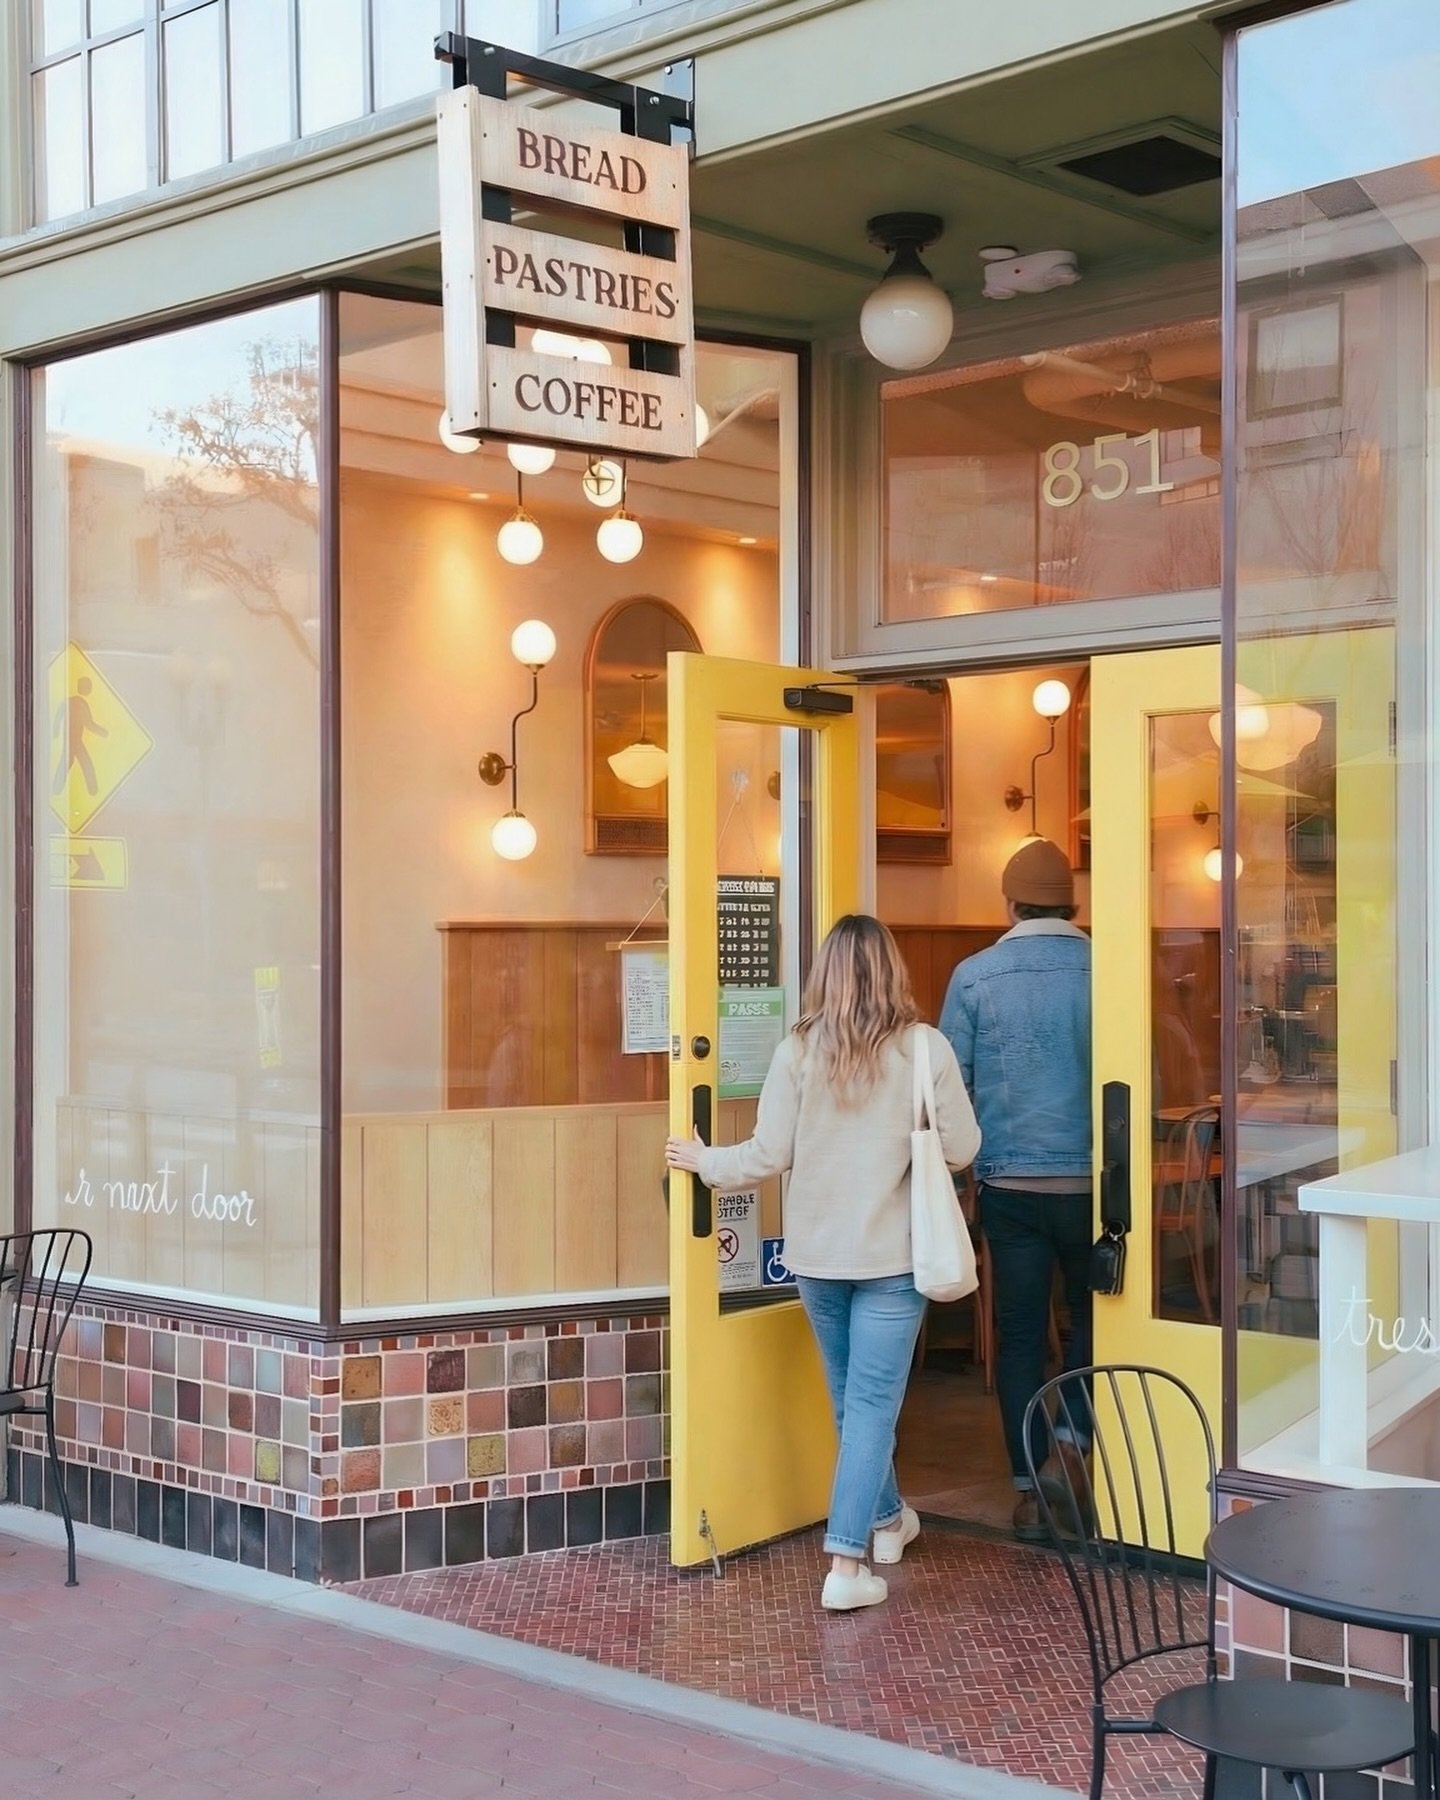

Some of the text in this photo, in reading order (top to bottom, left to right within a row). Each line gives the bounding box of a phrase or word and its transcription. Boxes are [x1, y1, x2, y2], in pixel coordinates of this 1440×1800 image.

[517, 127, 646, 194] BREAD
[492, 245, 676, 319] PASTRIES
[515, 373, 662, 430] COFFEE
[1042, 428, 1174, 507] 851
[192, 1163, 257, 1227] door
[1332, 1285, 1440, 1354] tres
